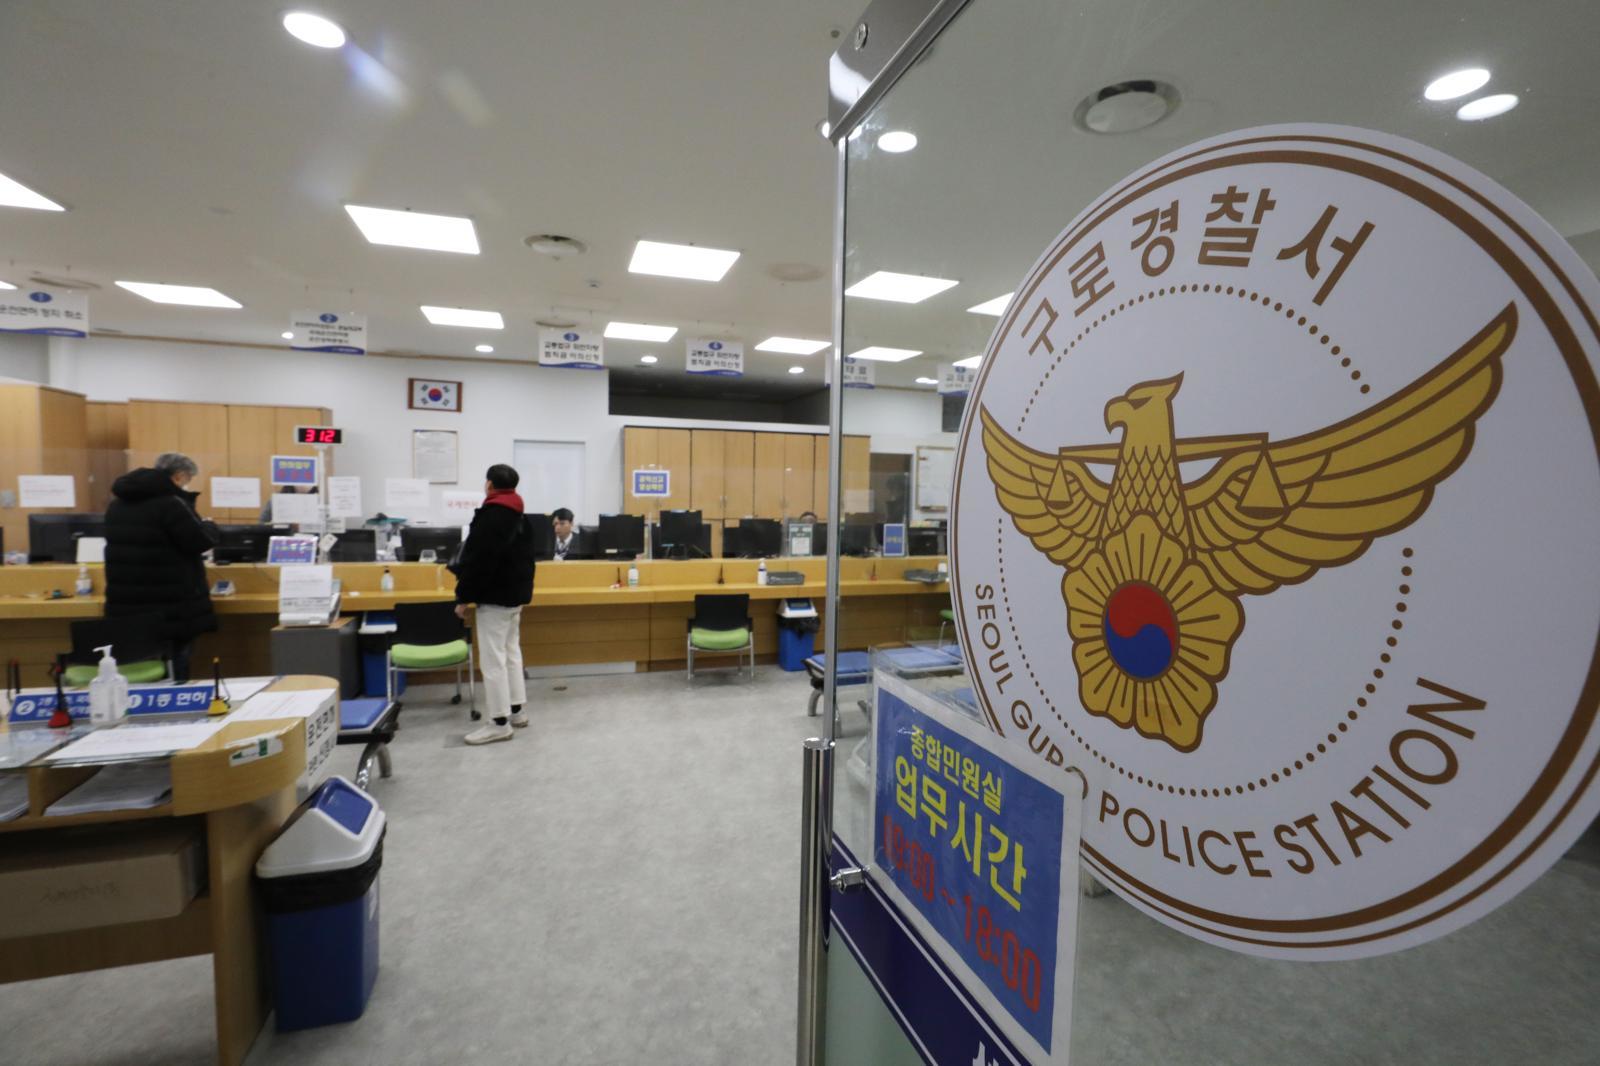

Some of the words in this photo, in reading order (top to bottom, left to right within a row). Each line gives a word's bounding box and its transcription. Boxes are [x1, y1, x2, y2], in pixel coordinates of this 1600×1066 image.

[1021, 185, 1376, 356] 구로경찰서
[305, 429, 336, 443] 312
[975, 583, 1013, 695] SEOUL
[147, 693, 171, 708] 1종
[176, 691, 208, 707] 면허
[911, 724, 1002, 825] 종합민원실
[1273, 677, 1487, 875] STATION
[895, 755, 1027, 912] 업무시간
[1100, 790, 1272, 877] POLICE
[963, 895, 1042, 1012] 18:00
